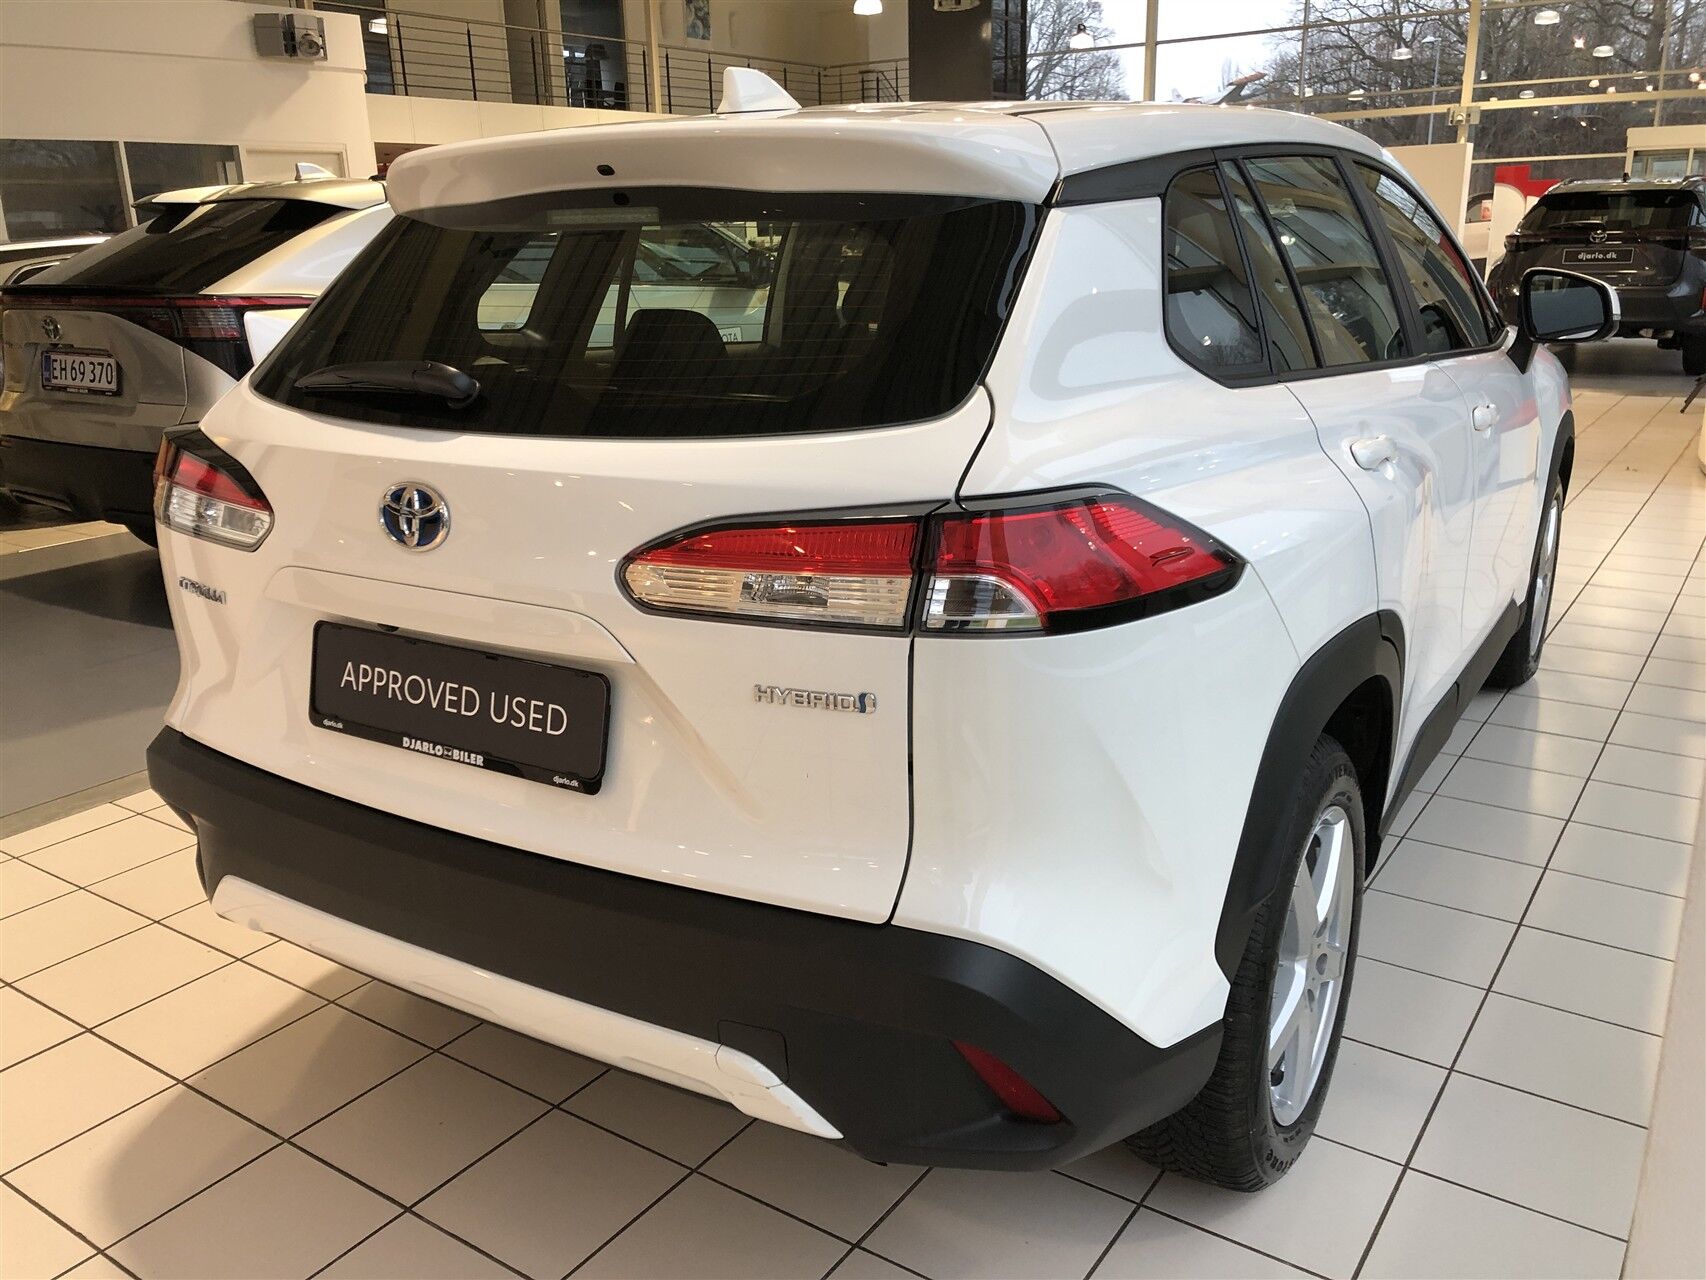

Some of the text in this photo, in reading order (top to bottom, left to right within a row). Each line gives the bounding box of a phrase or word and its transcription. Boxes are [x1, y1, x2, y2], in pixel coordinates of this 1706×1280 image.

[1578, 251, 1617, 261] djarlo.dk
[51, 358, 114, 385] EH 69 370
[340, 661, 568, 736] APPROVED USED
[754, 684, 859, 713] HYBRID
[402, 736, 484, 767] DJARLO BILER
